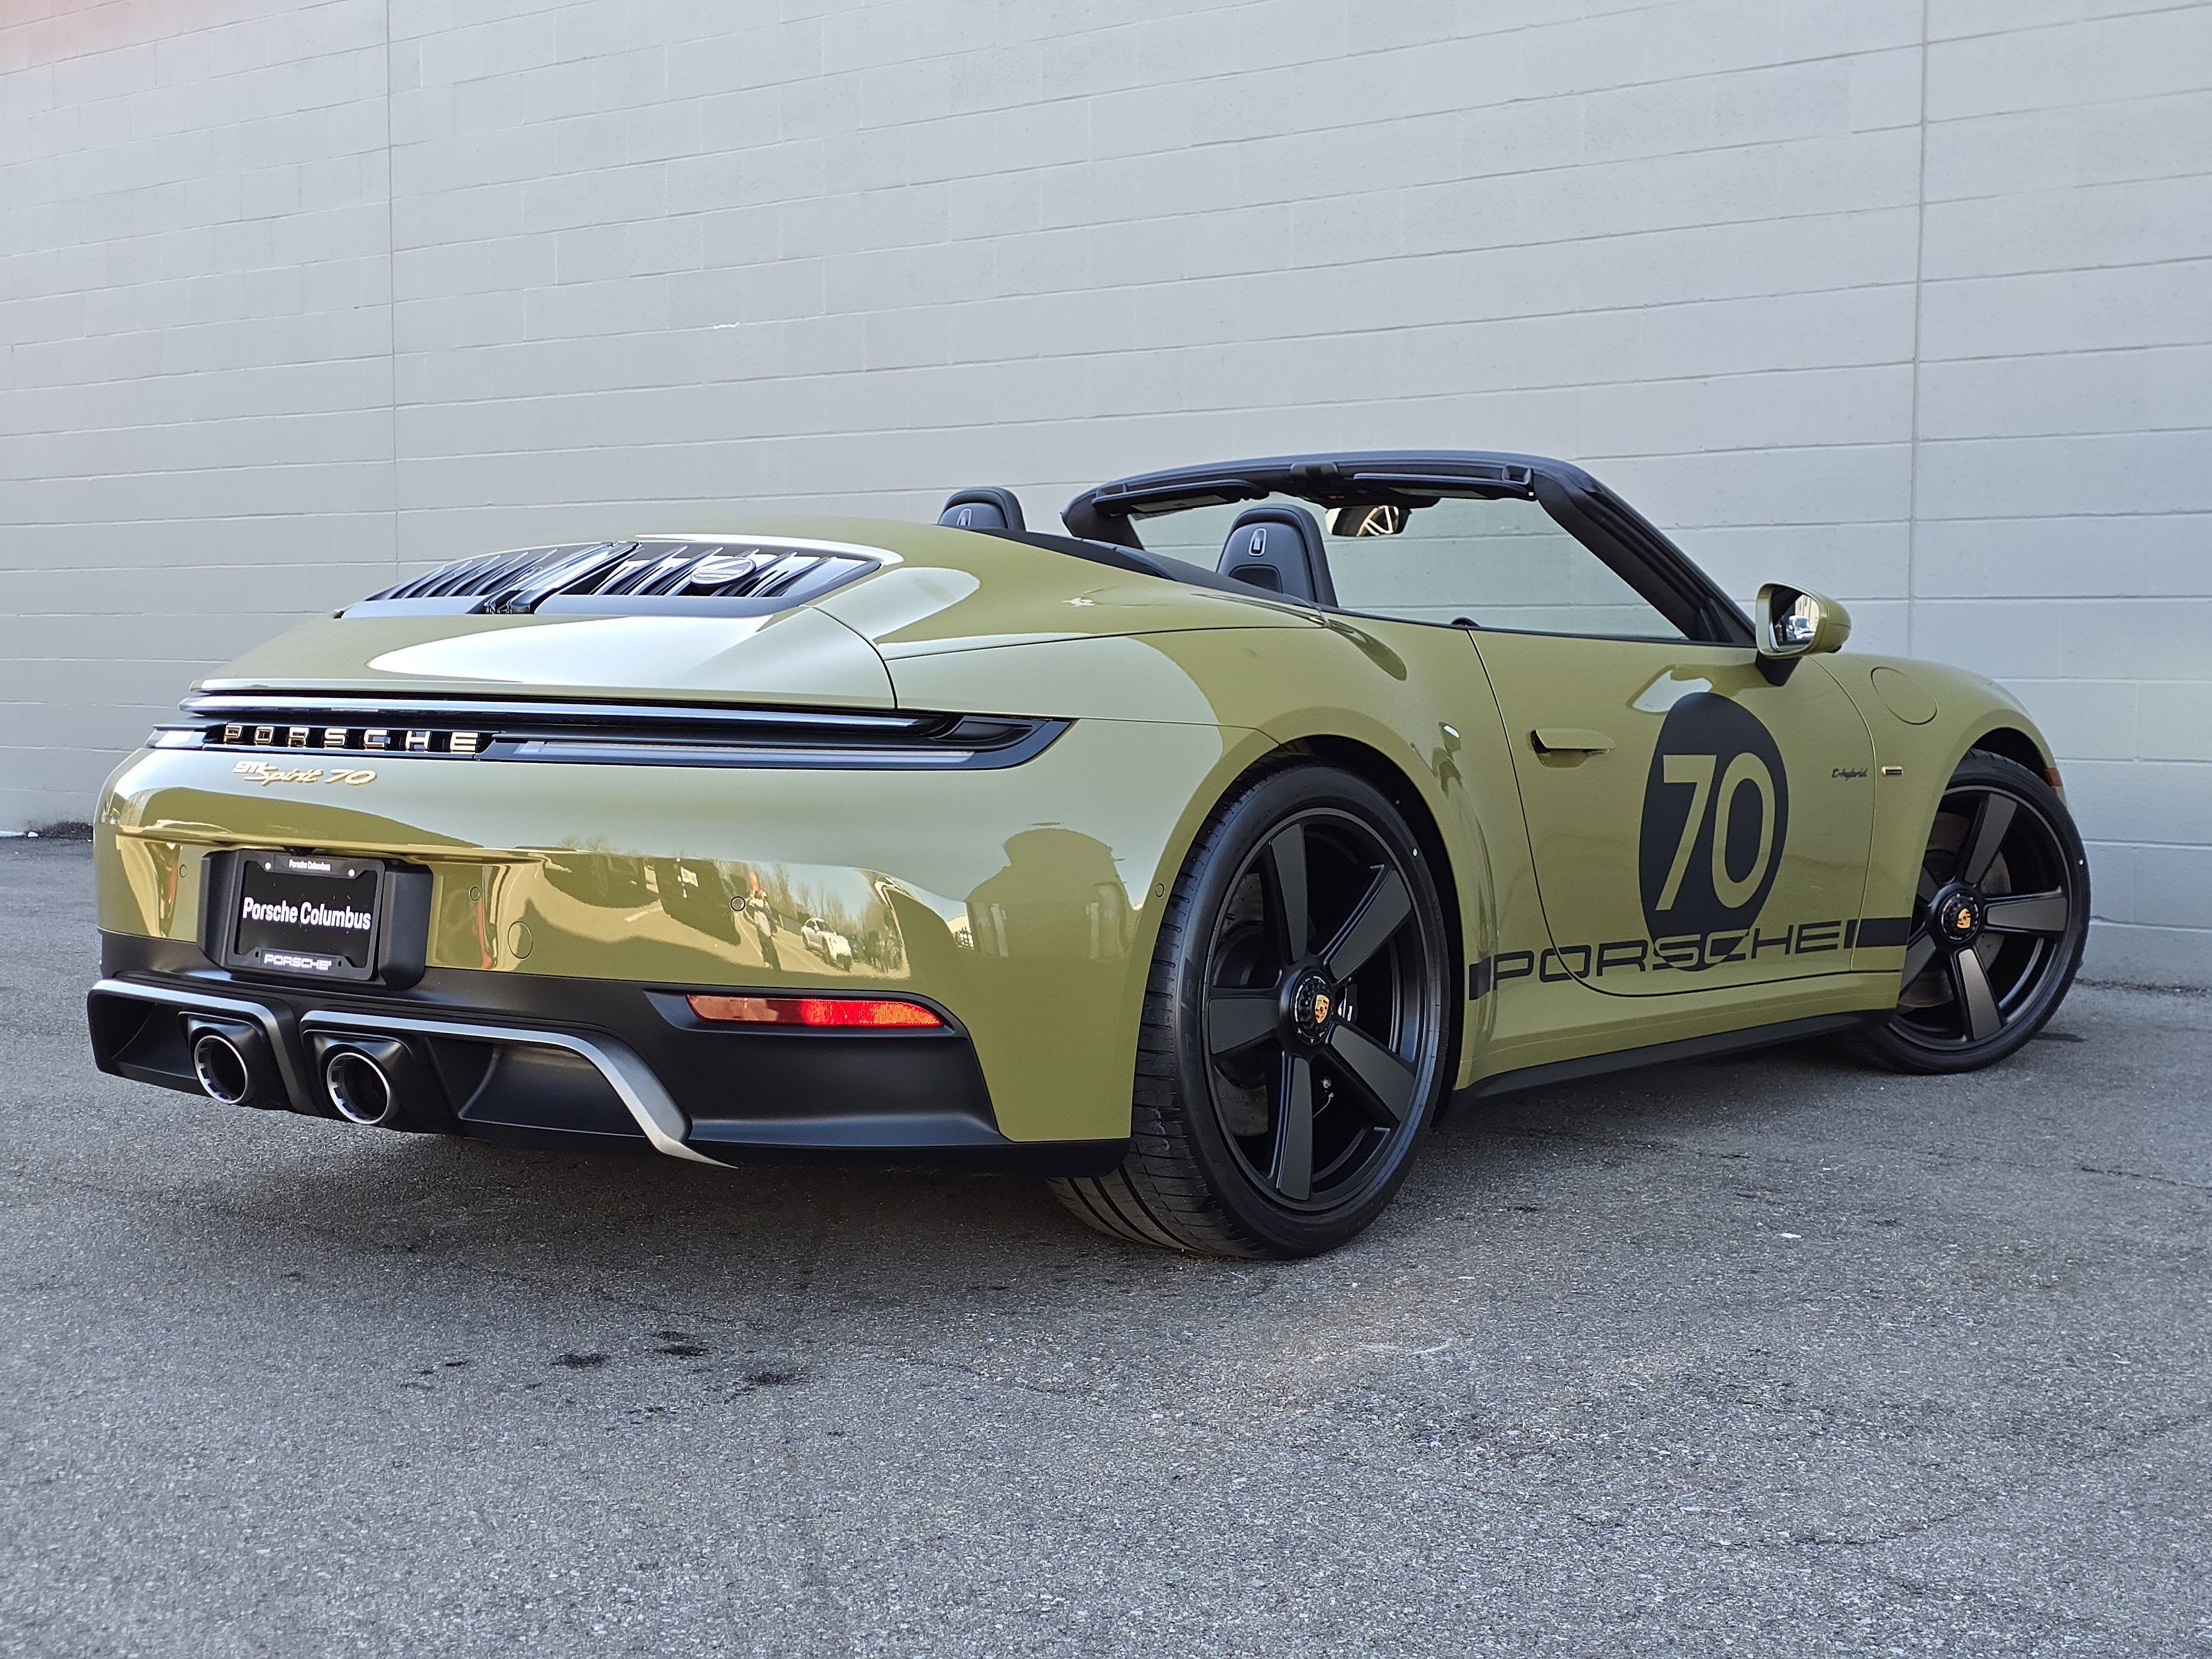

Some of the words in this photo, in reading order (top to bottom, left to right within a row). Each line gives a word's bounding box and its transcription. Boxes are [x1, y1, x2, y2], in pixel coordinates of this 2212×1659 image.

[223, 724, 479, 754] PORSCHE
[243, 764, 324, 786] Spirit
[324, 768, 377, 785] 70
[1655, 752, 1776, 911] 70
[242, 897, 298, 924] Porsche
[300, 901, 371, 930] Columbus
[1493, 920, 1842, 990] PORSCHE
